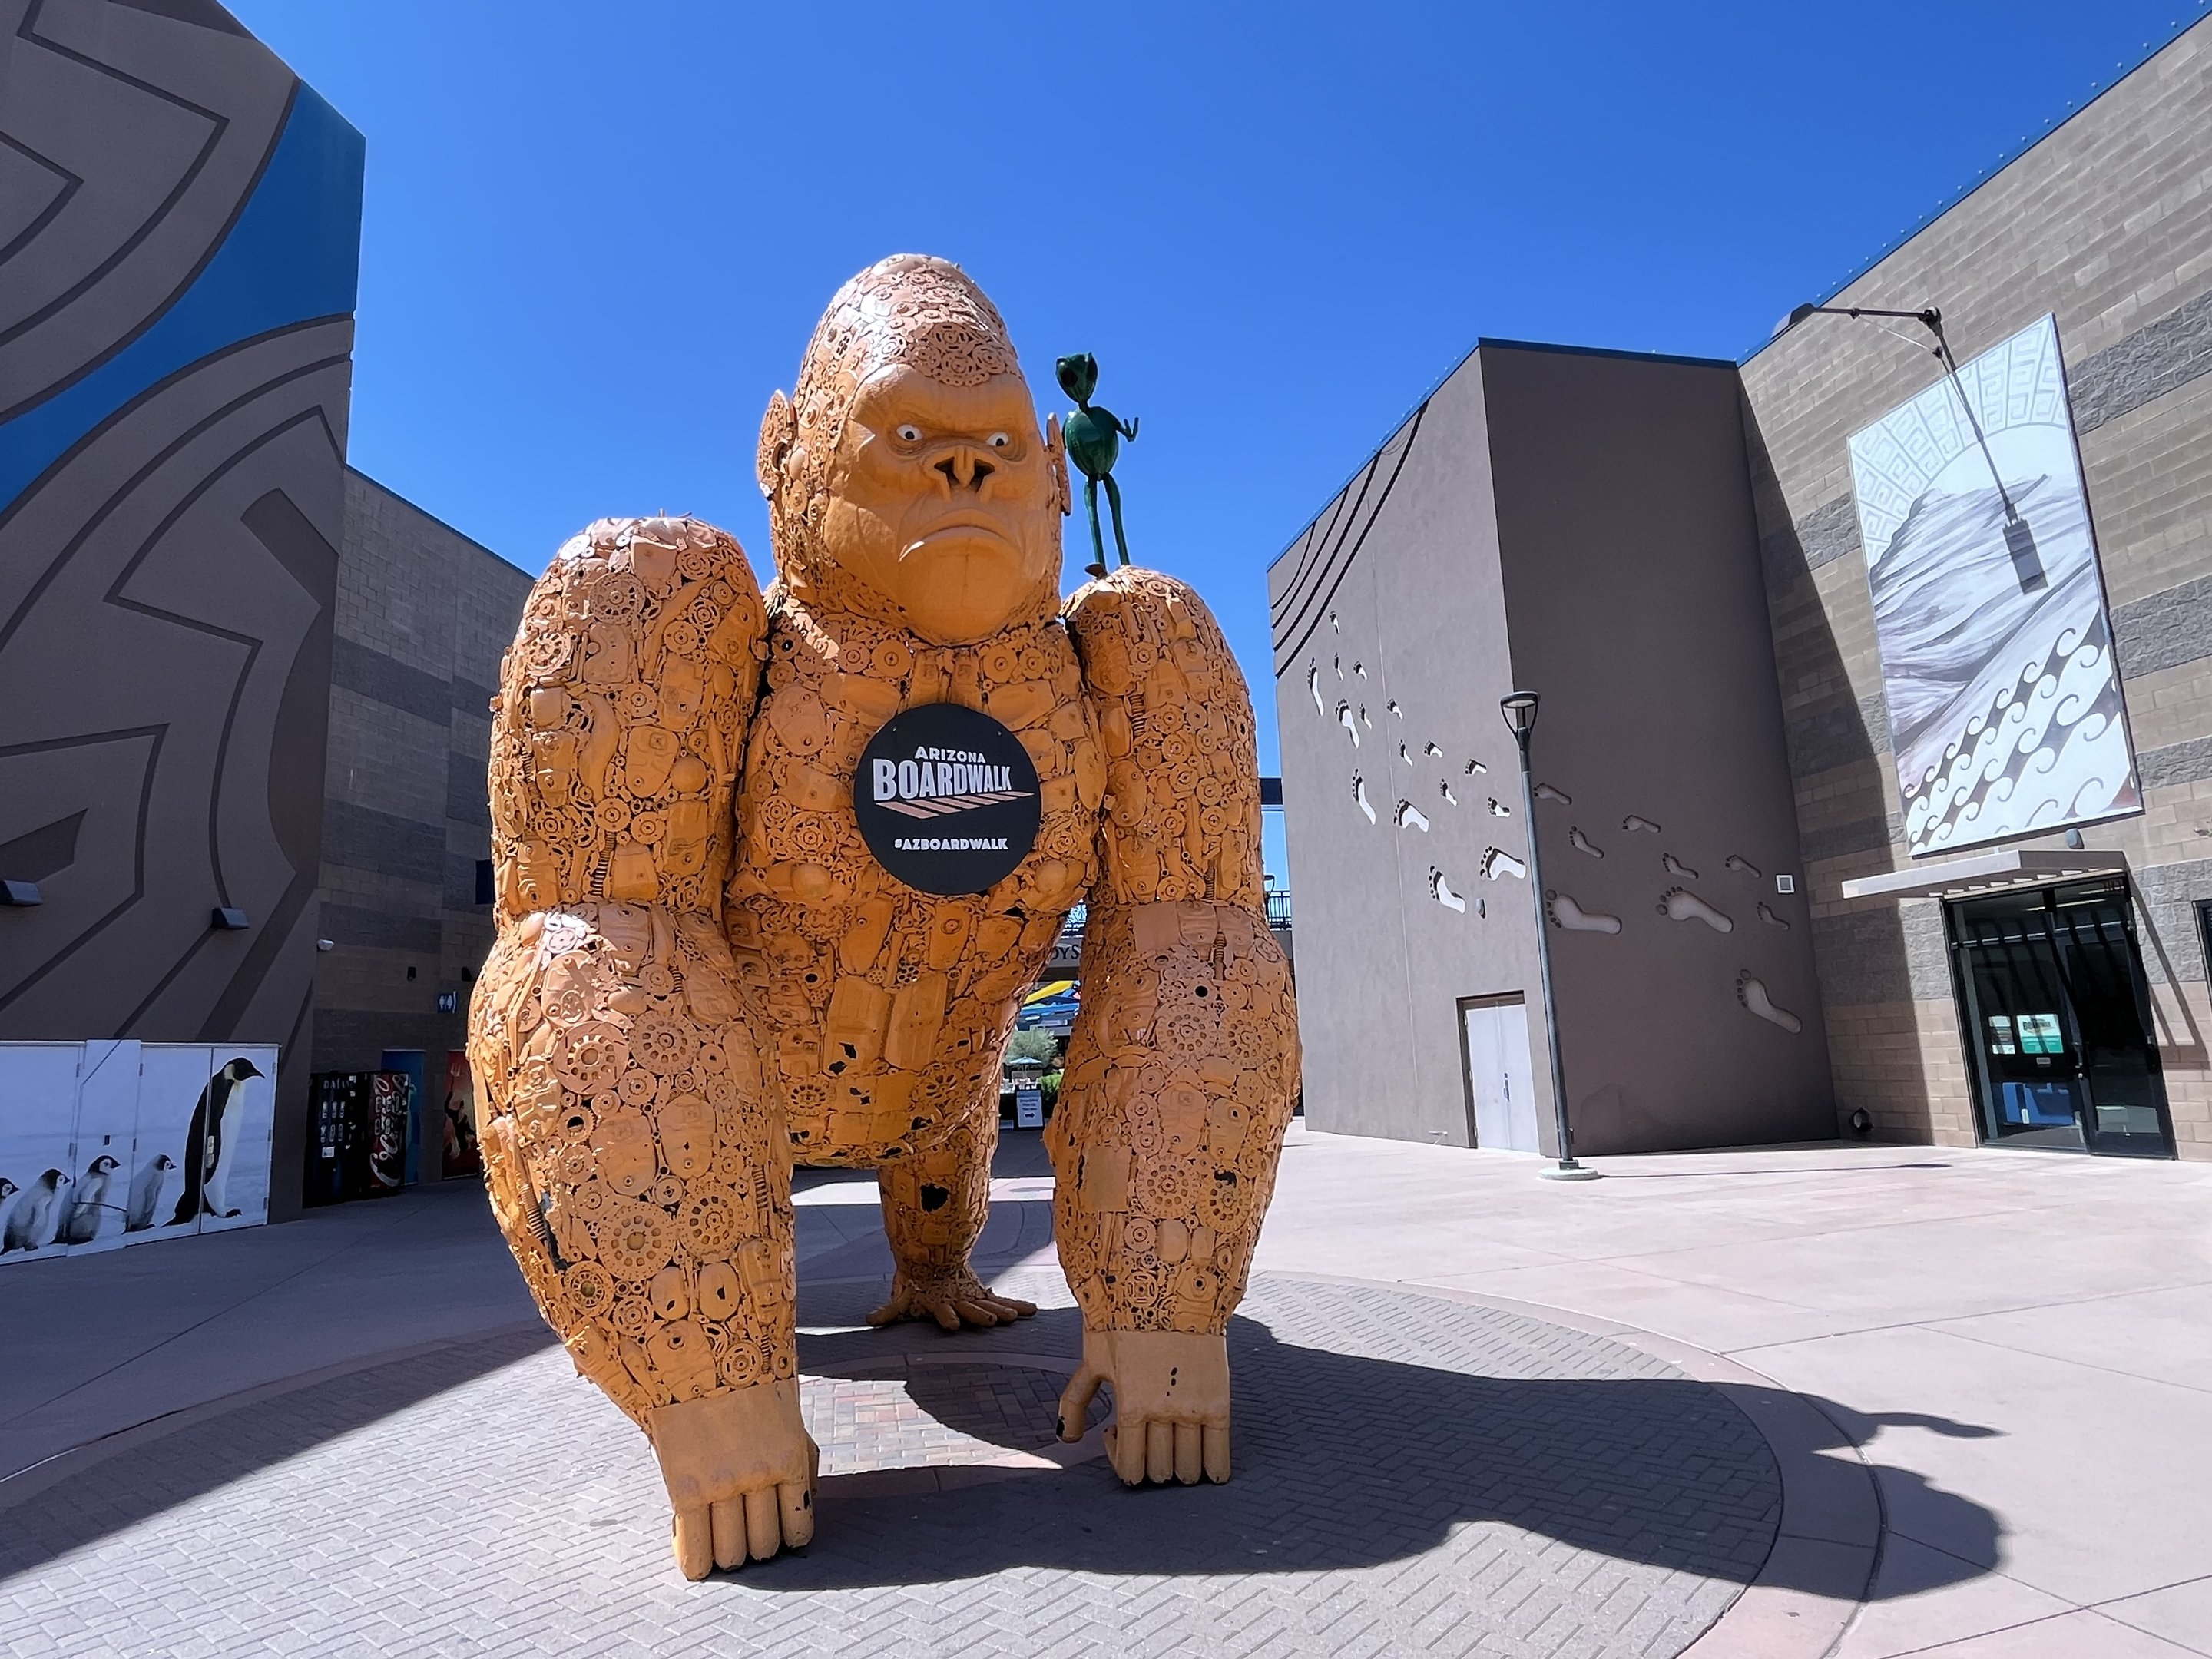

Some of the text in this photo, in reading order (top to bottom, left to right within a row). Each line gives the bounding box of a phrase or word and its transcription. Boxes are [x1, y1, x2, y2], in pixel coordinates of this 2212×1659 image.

[914, 746, 986, 763] ARIZONA
[873, 758, 1012, 801] BOARDWALK
[894, 838, 1008, 850] #AZBOARDWALK
